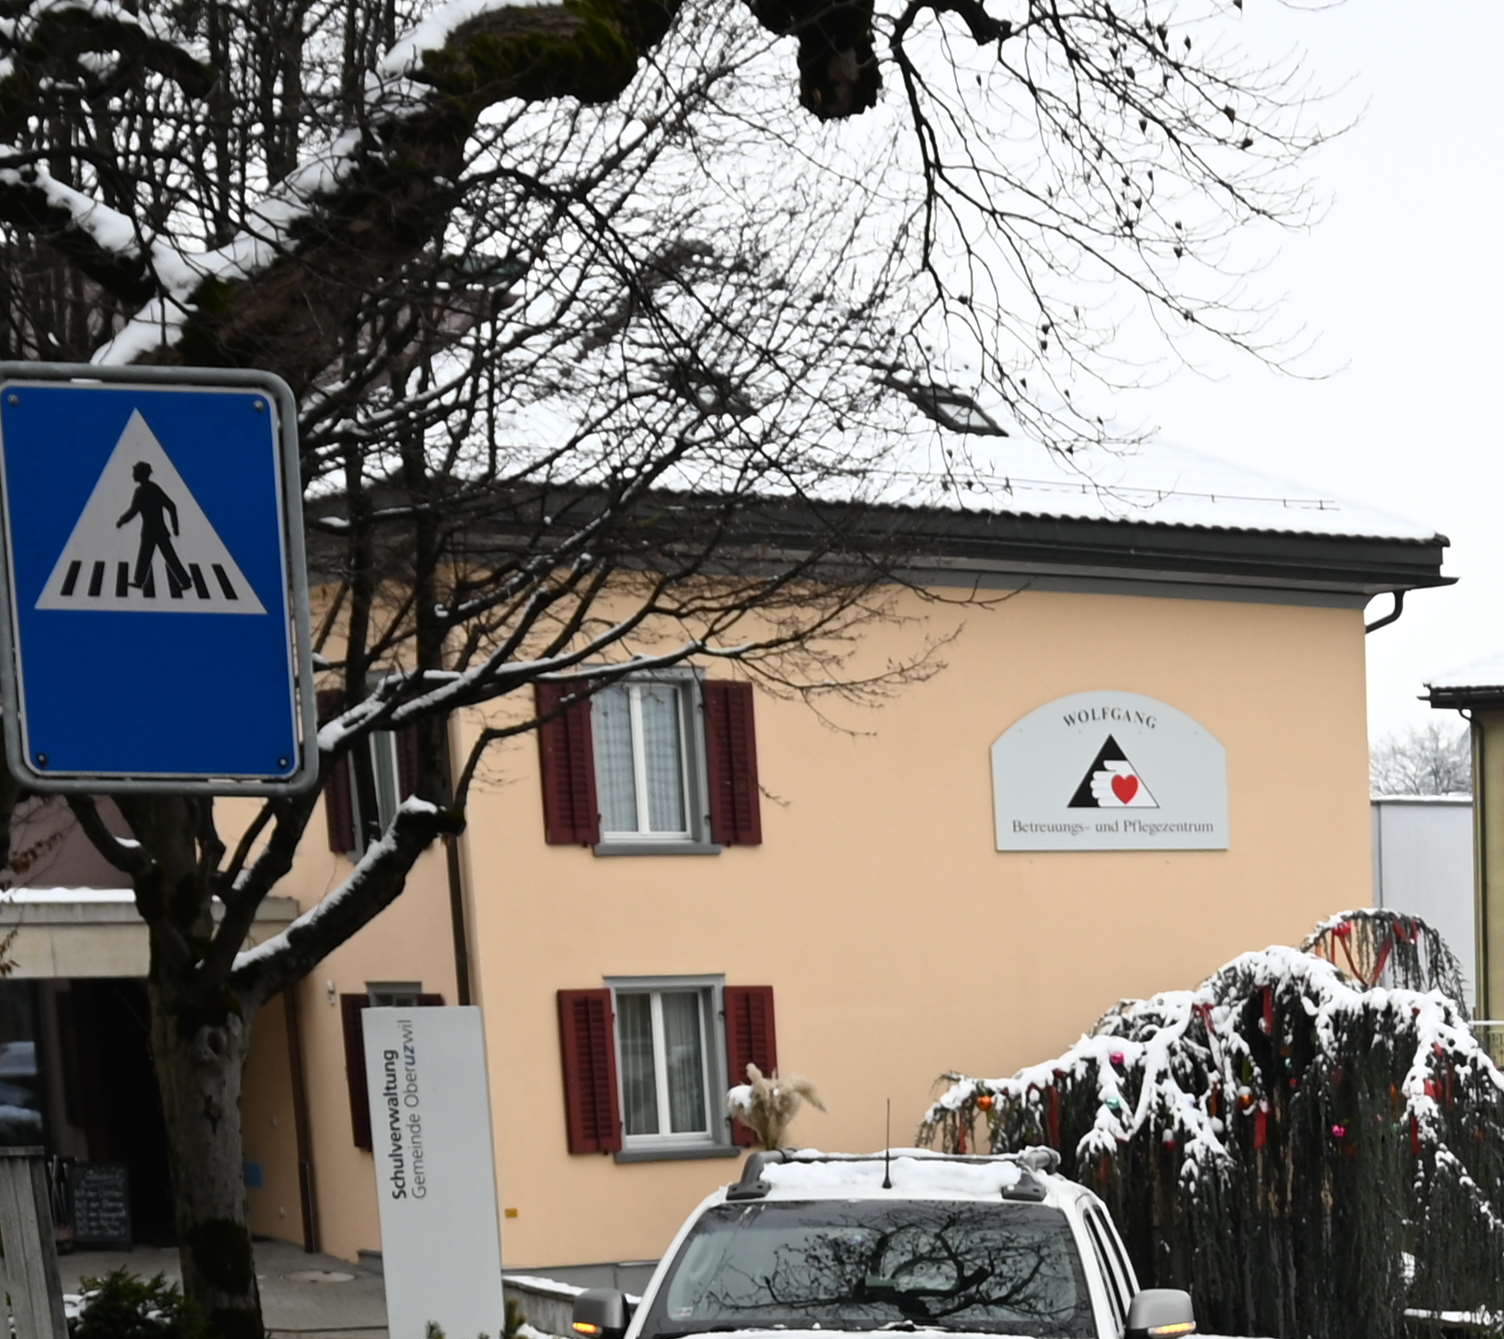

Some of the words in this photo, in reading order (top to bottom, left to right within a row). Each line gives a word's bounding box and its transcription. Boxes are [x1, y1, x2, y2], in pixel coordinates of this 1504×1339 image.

[1062, 706, 1158, 730] WOLFGANG
[1012, 819, 1091, 836] Betreuungs-
[1095, 820, 1119, 833] und
[1123, 819, 1214, 836] Pflegezentrum
[397, 1019, 420, 1109] Oberuzwil
[382, 1049, 407, 1200] Schulverwaltung
[406, 1112, 427, 1200] Gemeinde
